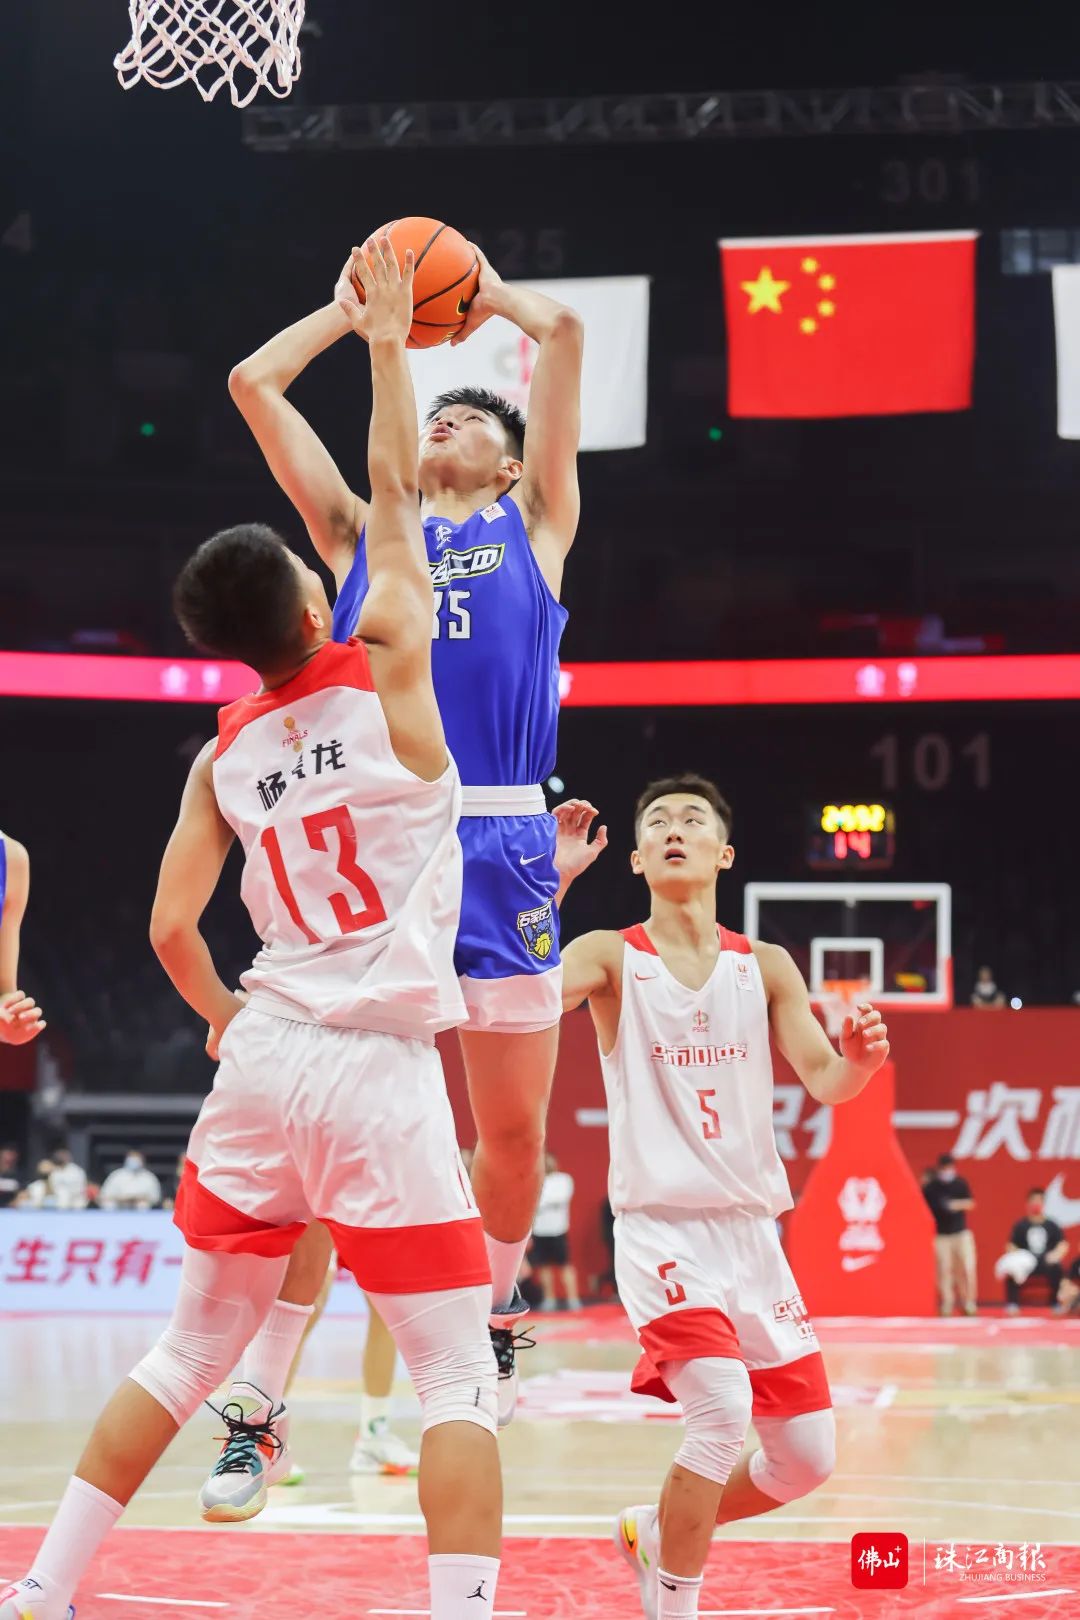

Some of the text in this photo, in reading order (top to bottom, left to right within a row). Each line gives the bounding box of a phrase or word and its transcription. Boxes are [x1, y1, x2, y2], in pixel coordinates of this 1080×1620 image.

[282, 729, 309, 748] FINALS
[868, 731, 992, 792] 101
[256, 739, 346, 812] 杨龙
[260, 804, 388, 945] 13
[696, 1088, 722, 1139] 5
[657, 1260, 688, 1306] 5
